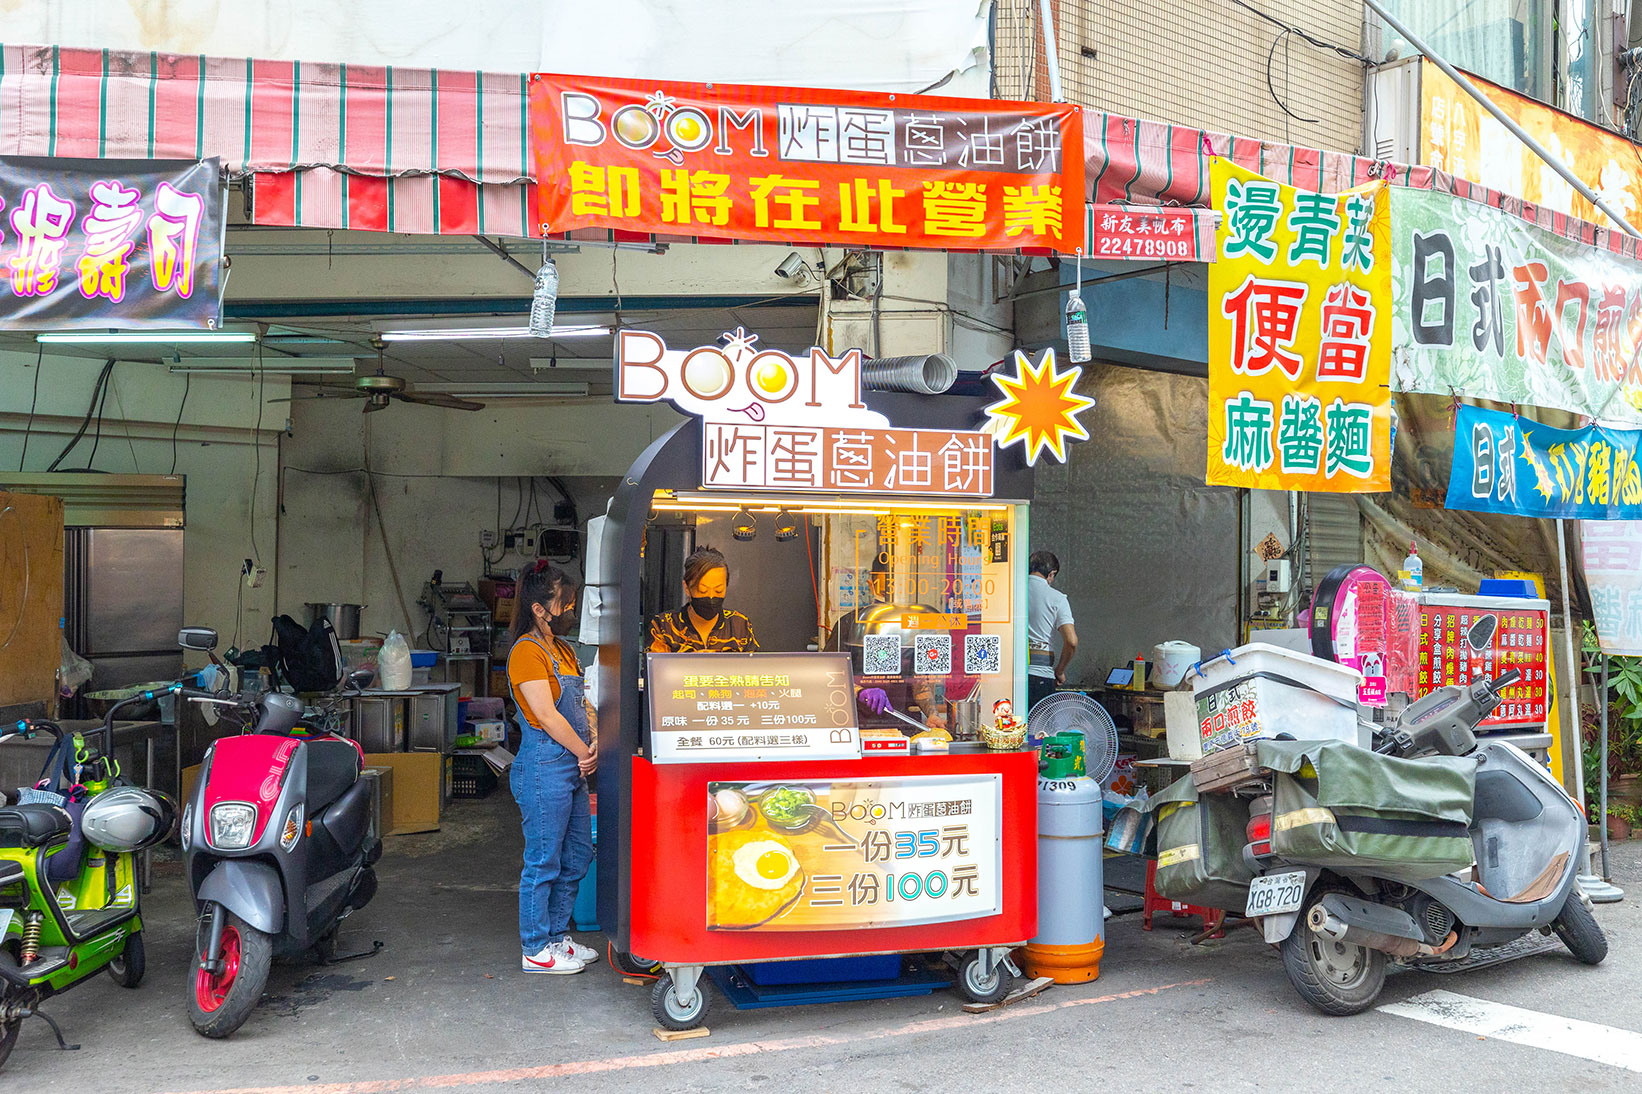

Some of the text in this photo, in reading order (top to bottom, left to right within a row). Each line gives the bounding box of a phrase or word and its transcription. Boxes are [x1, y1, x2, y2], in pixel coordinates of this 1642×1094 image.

[560, 90, 770, 158] BOOM
[568, 161, 1064, 238] 即將在此營業
[1226, 179, 1374, 271] 燙青菜
[1100, 237, 1188, 256] 22478908
[1223, 275, 1375, 380] 便當
[619, 331, 866, 408] BOOM
[1225, 393, 1374, 477] 麻醬麵
[877, 514, 991, 547] 營業時間
[878, 551, 991, 568] Opening Hours
[872, 579, 996, 595] 13:00-20:00
[1535, 618, 1544, 629] 50
[1535, 635, 1543, 646] 50
[1535, 652, 1543, 663] 40
[683, 675, 790, 688] 蛋要全熟請告知
[1534, 671, 1543, 681] 30
[1534, 687, 1543, 698] 30
[825, 670, 852, 744] BOOM
[1534, 704, 1543, 715] 30
[662, 715, 688, 727] 原味
[1201, 699, 1256, 740] 兩口煎餃
[676, 736, 703, 747] 全餐
[831, 801, 906, 821] BOOM
[824, 824, 970, 863] 一份35元
[810, 864, 979, 906] 三份100元
